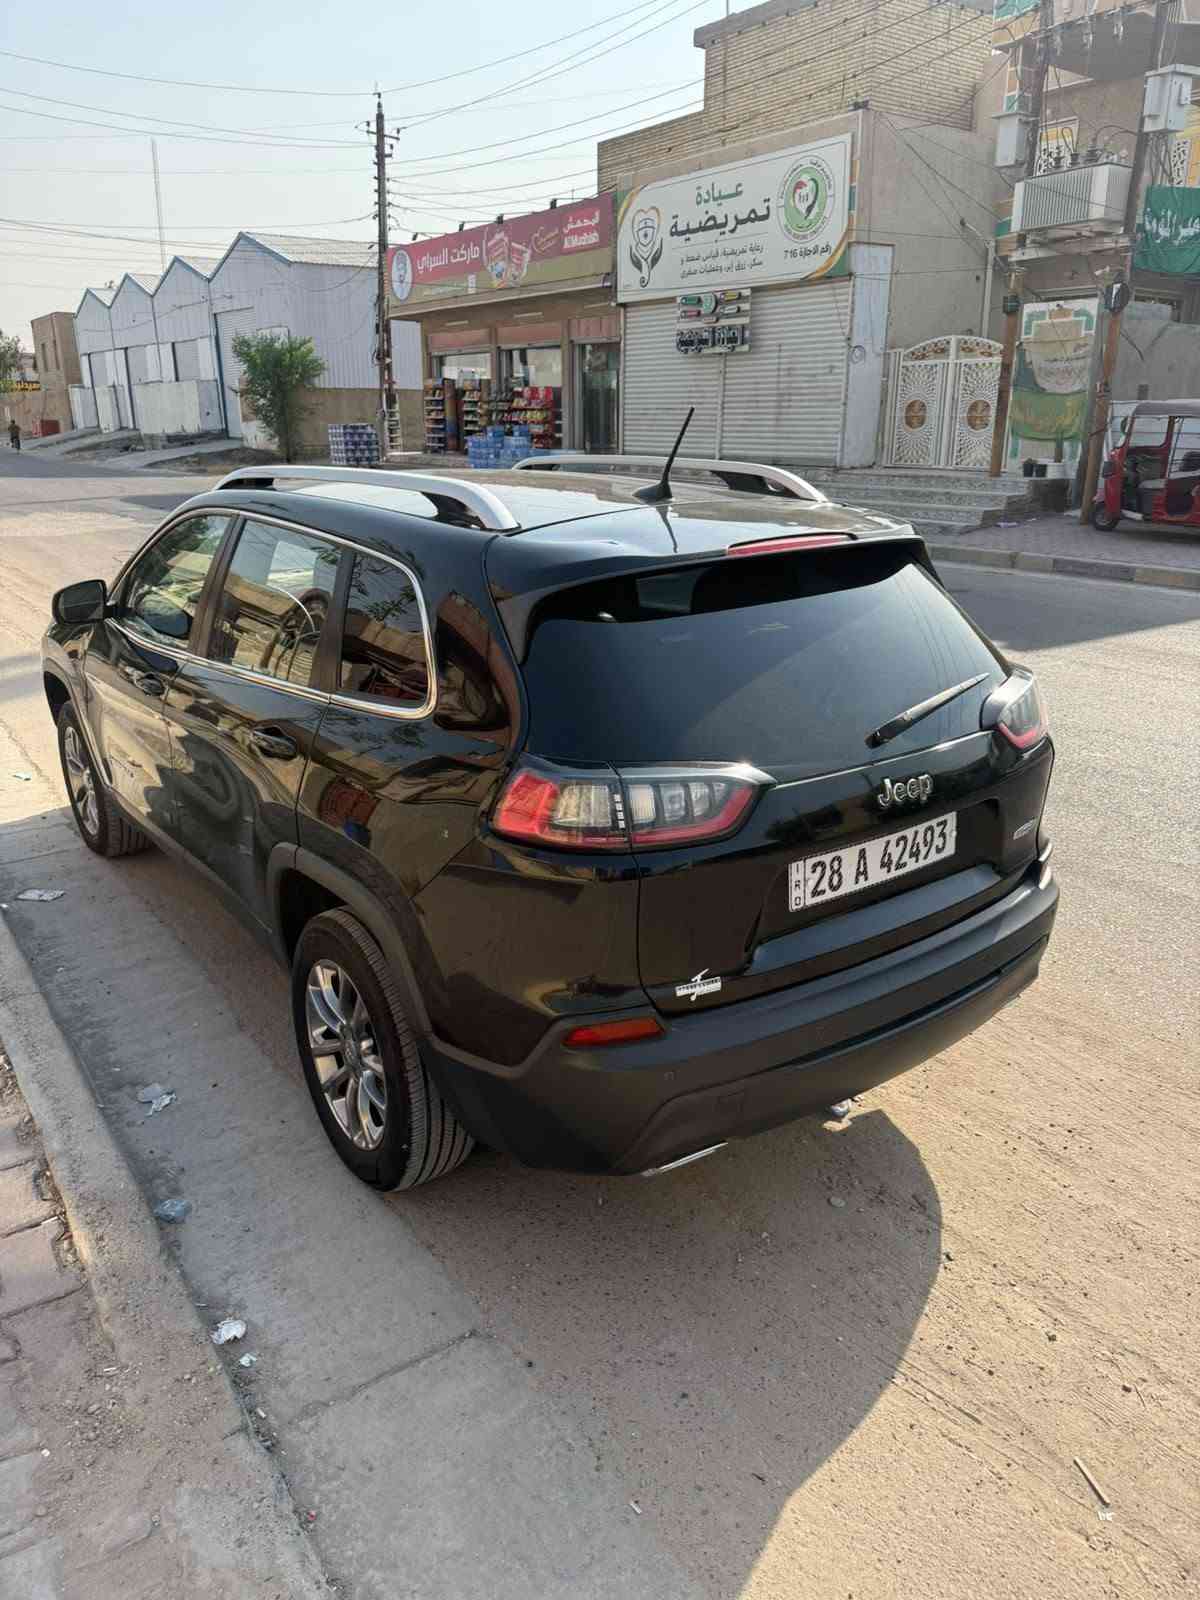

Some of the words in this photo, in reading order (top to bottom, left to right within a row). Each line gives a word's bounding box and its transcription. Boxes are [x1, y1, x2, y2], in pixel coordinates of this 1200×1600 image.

[696, 182, 743, 206] عيادة
[670, 197, 770, 241] تمريضية
[450, 242, 480, 264] ماركت
[877, 774, 933, 810] Jeep
[810, 855, 843, 899] 28
[854, 847, 869, 885] A
[879, 819, 948, 874] 42493
